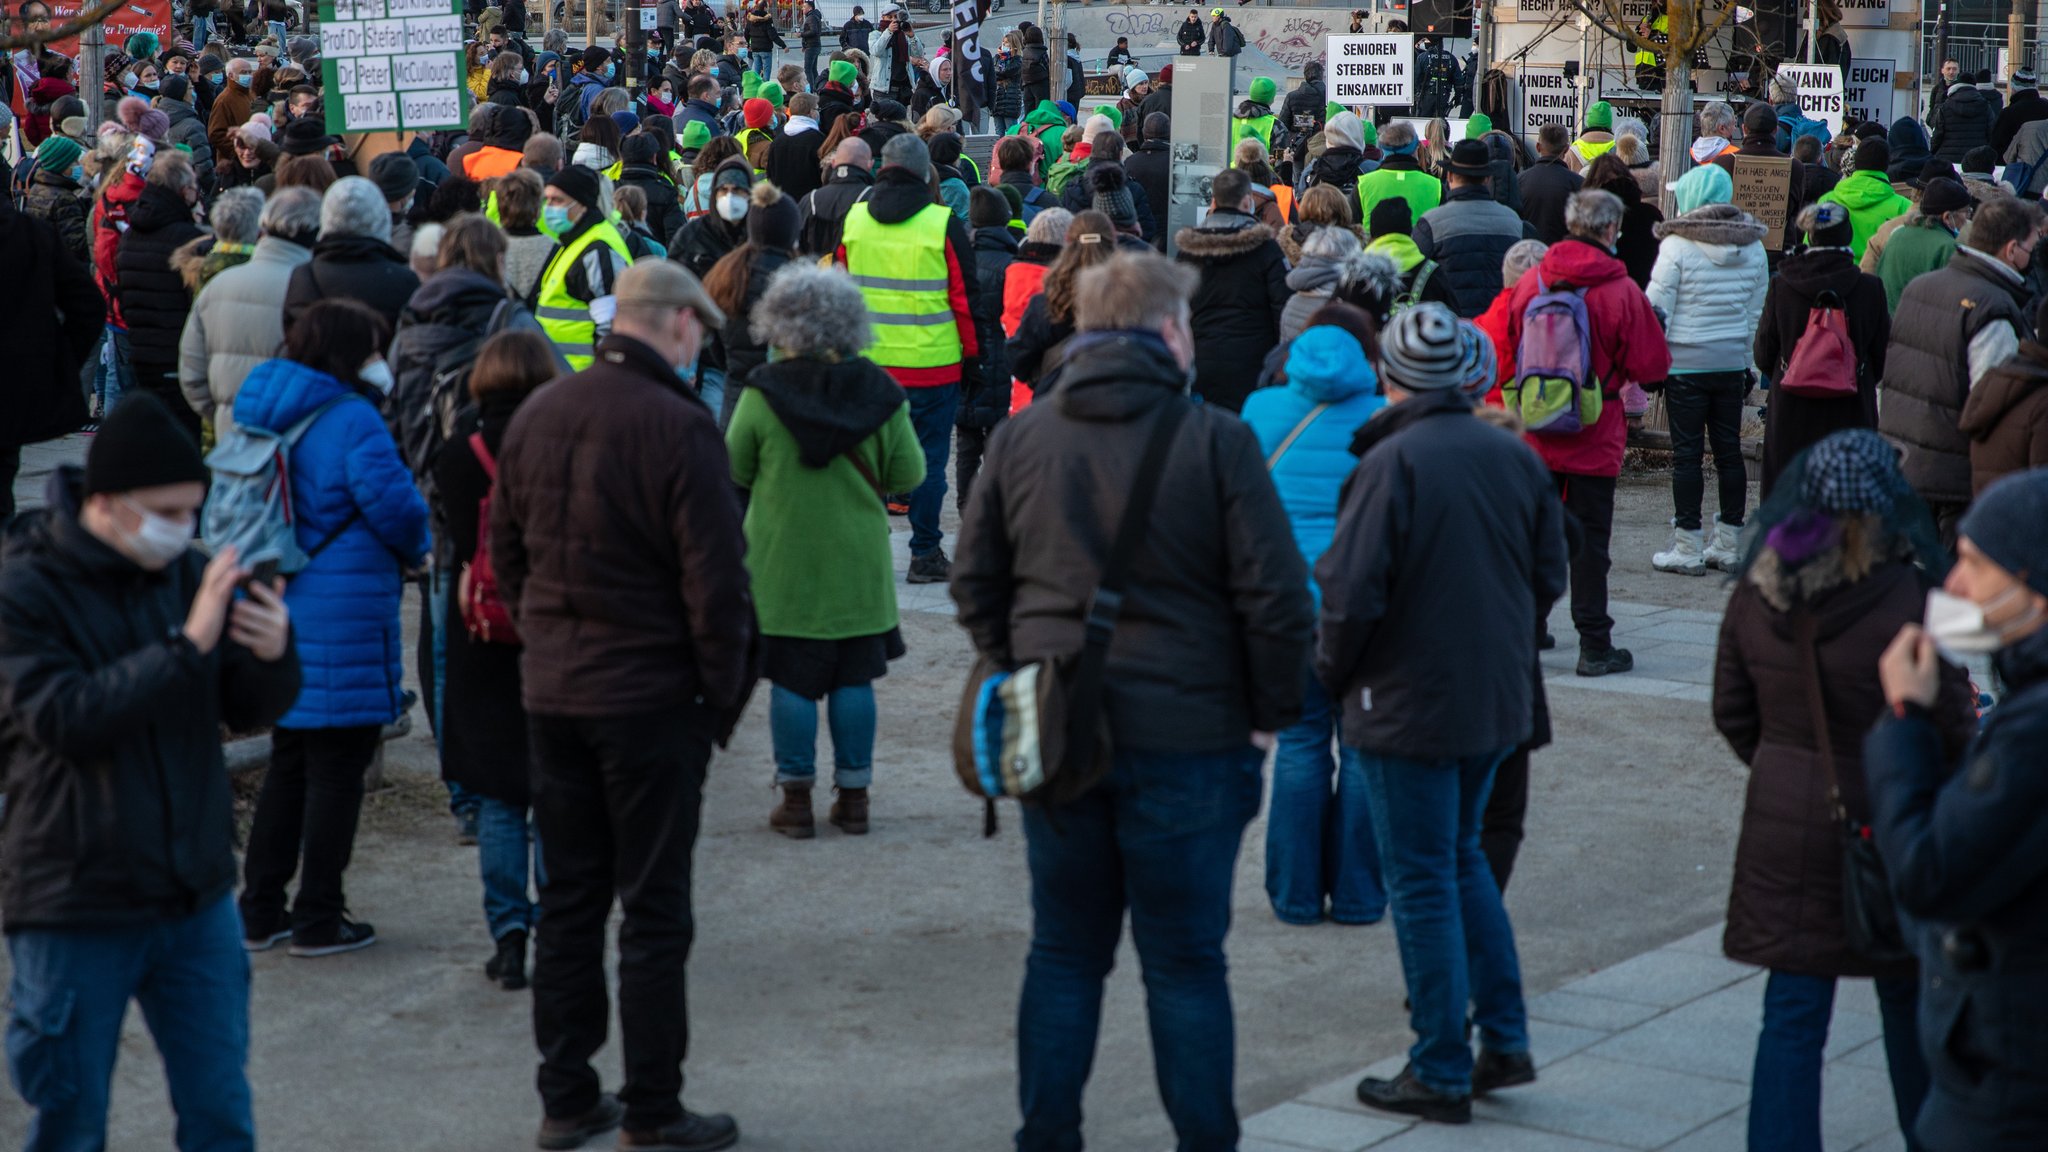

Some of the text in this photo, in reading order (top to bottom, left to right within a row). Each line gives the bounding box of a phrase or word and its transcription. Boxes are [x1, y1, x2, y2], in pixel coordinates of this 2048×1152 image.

[54, 5, 74, 17] Wer
[1520, 0, 1554, 11] RECHT
[102, 25, 115, 34] er
[366, 25, 404, 49] Stefan
[407, 22, 461, 46] Hockertz
[1343, 43, 1397, 56] SENIOREN
[359, 64, 388, 85] Peter
[394, 59, 455, 88] McCullough
[1336, 63, 1404, 76] STERBEN IN
[1852, 68, 1889, 83] EUCH
[1520, 74, 1563, 89] KINDER
[1567, 76, 1595, 90] SD
[1787, 71, 1833, 89] WANN
[1336, 83, 1404, 96] EINSAMKEIT
[346, 97, 458, 127] John P A Ioannidis
[1735, 166, 1791, 178] ICH HABE ANGST
[1740, 184, 1781, 193] MASSIVEN
